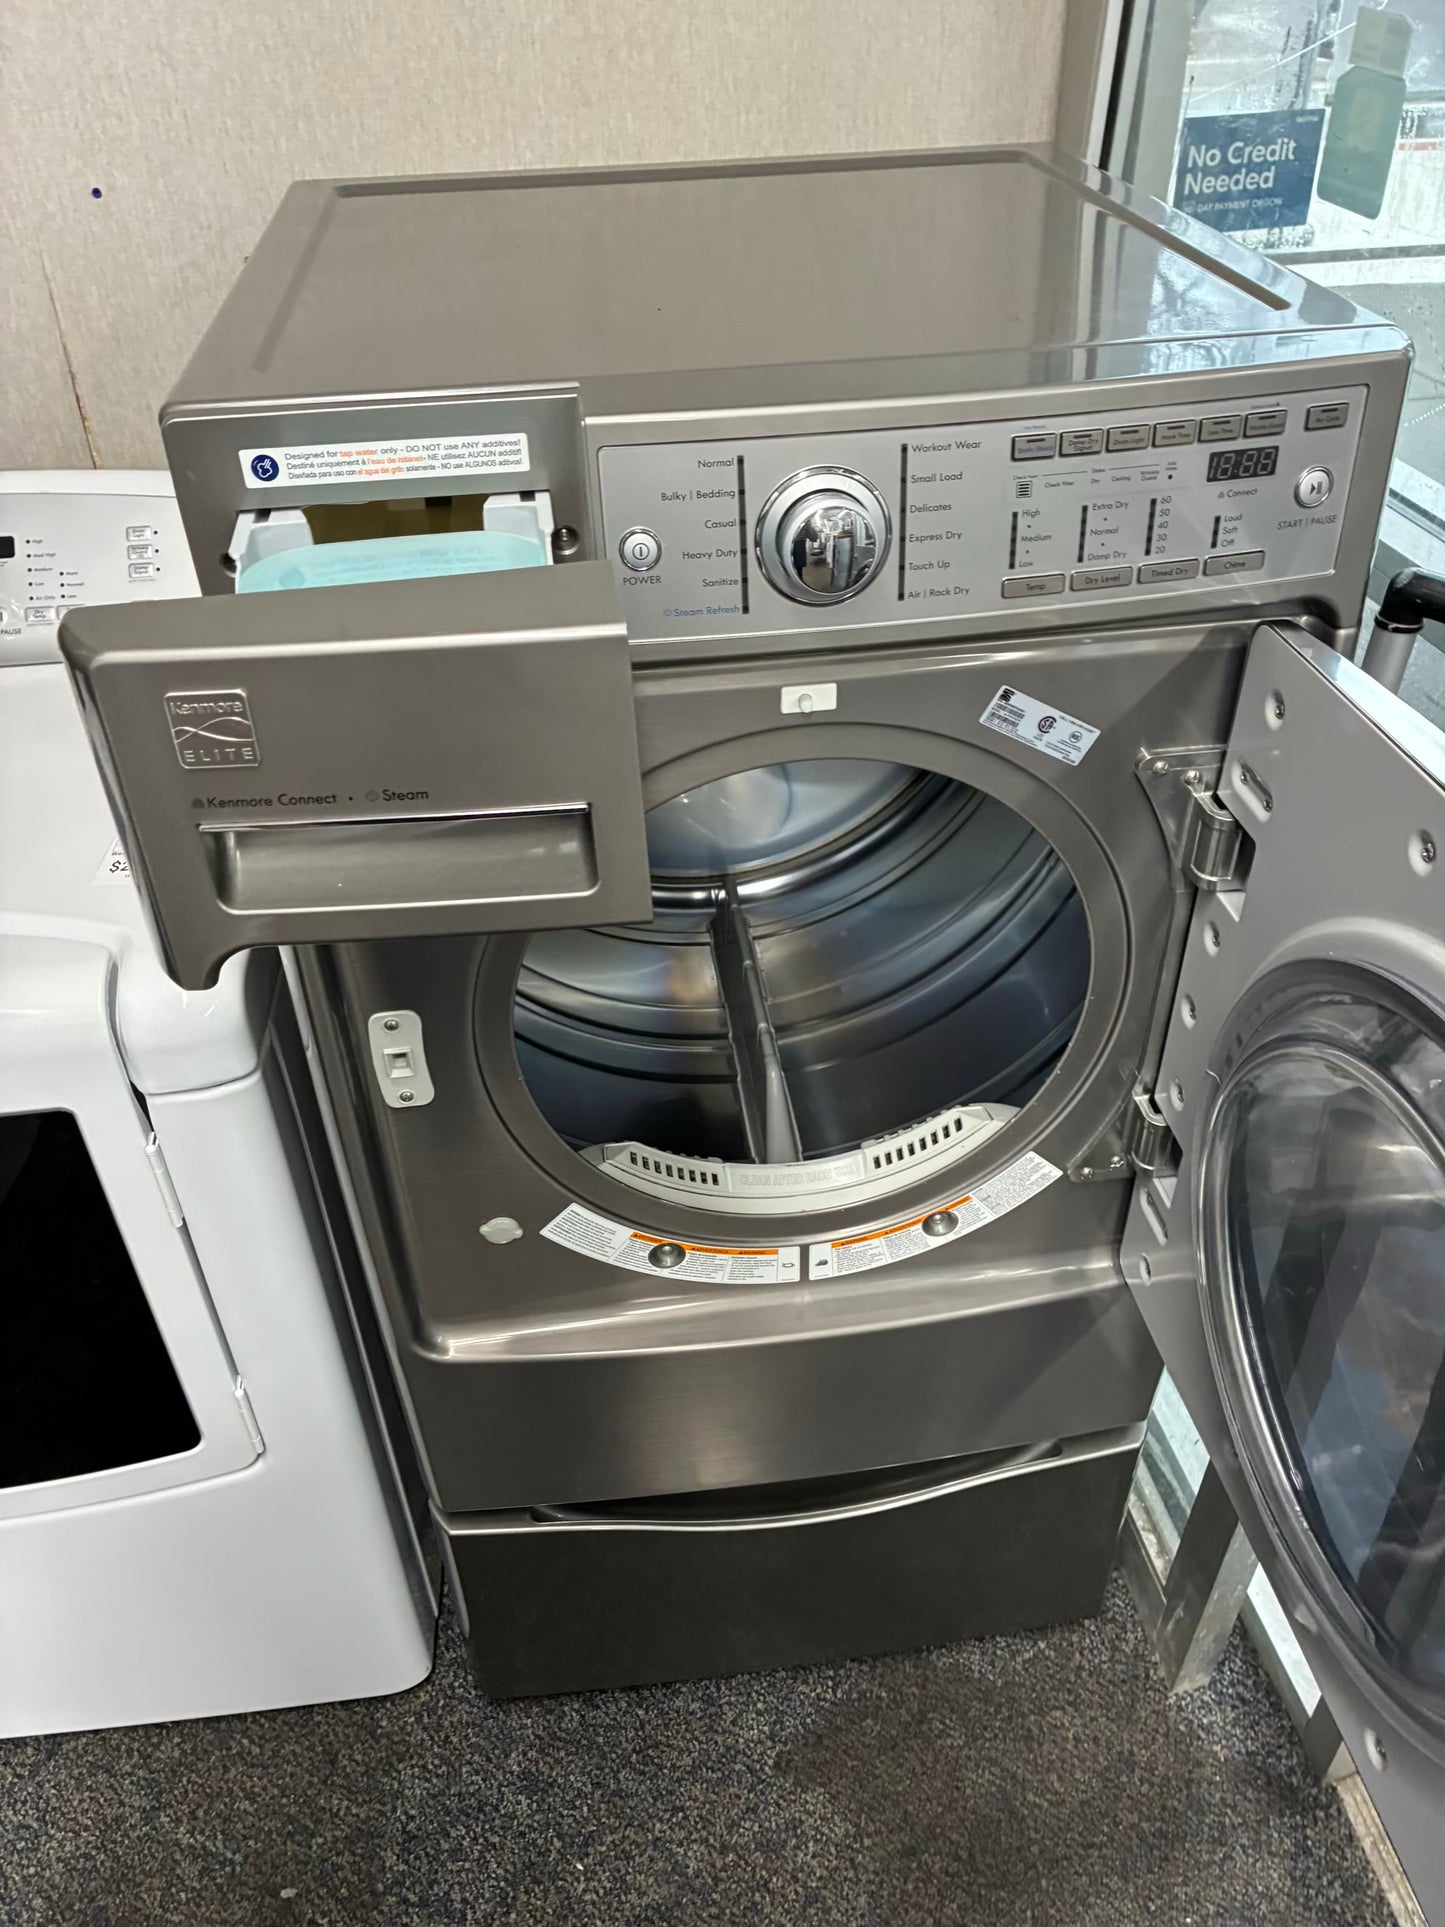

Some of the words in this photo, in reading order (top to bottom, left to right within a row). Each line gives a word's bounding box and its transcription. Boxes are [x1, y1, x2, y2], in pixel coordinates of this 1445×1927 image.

[1187, 144, 1222, 168] No
[1227, 138, 1298, 165] Credit
[1184, 165, 1276, 196] Needed
[284, 451, 325, 461] Designed
[326, 450, 338, 458] for
[340, 451, 353, 459] tap
[381, 446, 398, 455] only
[405, 445, 420, 453] DO
[421, 443, 442, 452] NOT
[461, 441, 480, 449] ANY
[482, 439, 521, 448] additives!
[911, 441, 954, 453] Workout
[957, 439, 982, 451] Wear
[317, 459, 360, 469] uniquement
[387, 456, 397, 464] de
[428, 453, 440, 461] NE
[440, 452, 466, 460] utilisez
[467, 450, 497, 459] AUCUN
[697, 457, 735, 469] Normal
[318, 471, 332, 479] para
[441, 462, 452, 470] NO
[464, 459, 497, 468] ALGUNOS
[910, 473, 937, 484] Small
[939, 471, 963, 482] Load
[661, 491, 687, 505] Bulky
[696, 488, 736, 502] Bedding
[1160, 495, 1172, 504] 60
[1226, 488, 1258, 499] Connect
[909, 502, 952, 514] Delicates
[1092, 503, 1113, 511] Extra
[1115, 500, 1130, 510] Dry
[1022, 509, 1041, 519] High
[1159, 508, 1171, 517] 50
[1223, 514, 1243, 523] Loud
[704, 518, 737, 530] Casual
[1157, 521, 1169, 529] 40
[1276, 518, 1303, 531] START
[1310, 514, 1338, 526] PAUSE
[1090, 526, 1119, 536] Normal
[1222, 526, 1239, 535] Soft
[908, 532, 942, 545] Express
[943, 530, 963, 543] Dry
[1020, 534, 1052, 543] Medium
[1156, 533, 1168, 542] 30
[1220, 539, 1235, 548] Off
[682, 550, 713, 563] Heavy
[715, 548, 738, 561] Duty
[1088, 552, 1111, 561] Damp
[1113, 550, 1127, 559] Dry
[1154, 546, 1166, 555] 20
[908, 561, 934, 572] Touch
[936, 559, 951, 572] Up
[1019, 560, 1034, 568] Low
[1223, 561, 1246, 570] Chime
[1151, 568, 1174, 577] Timed
[1175, 567, 1191, 577] Dry
[622, 574, 662, 586] POWER
[702, 576, 739, 588] Sanitize
[1101, 574, 1121, 583] Level
[907, 589, 922, 600] Air
[929, 586, 949, 598] Rack
[949, 585, 971, 598] Dry
[673, 607, 704, 618] Steam
[706, 604, 740, 616] Refresh
[0, 627, 22, 635] PAUSE
[170, 700, 244, 715] Kenmore
[183, 747, 254, 762] ELITE
[207, 795, 274, 810] Kenmore
[278, 793, 338, 807] Connect
[382, 788, 430, 802] Steam
